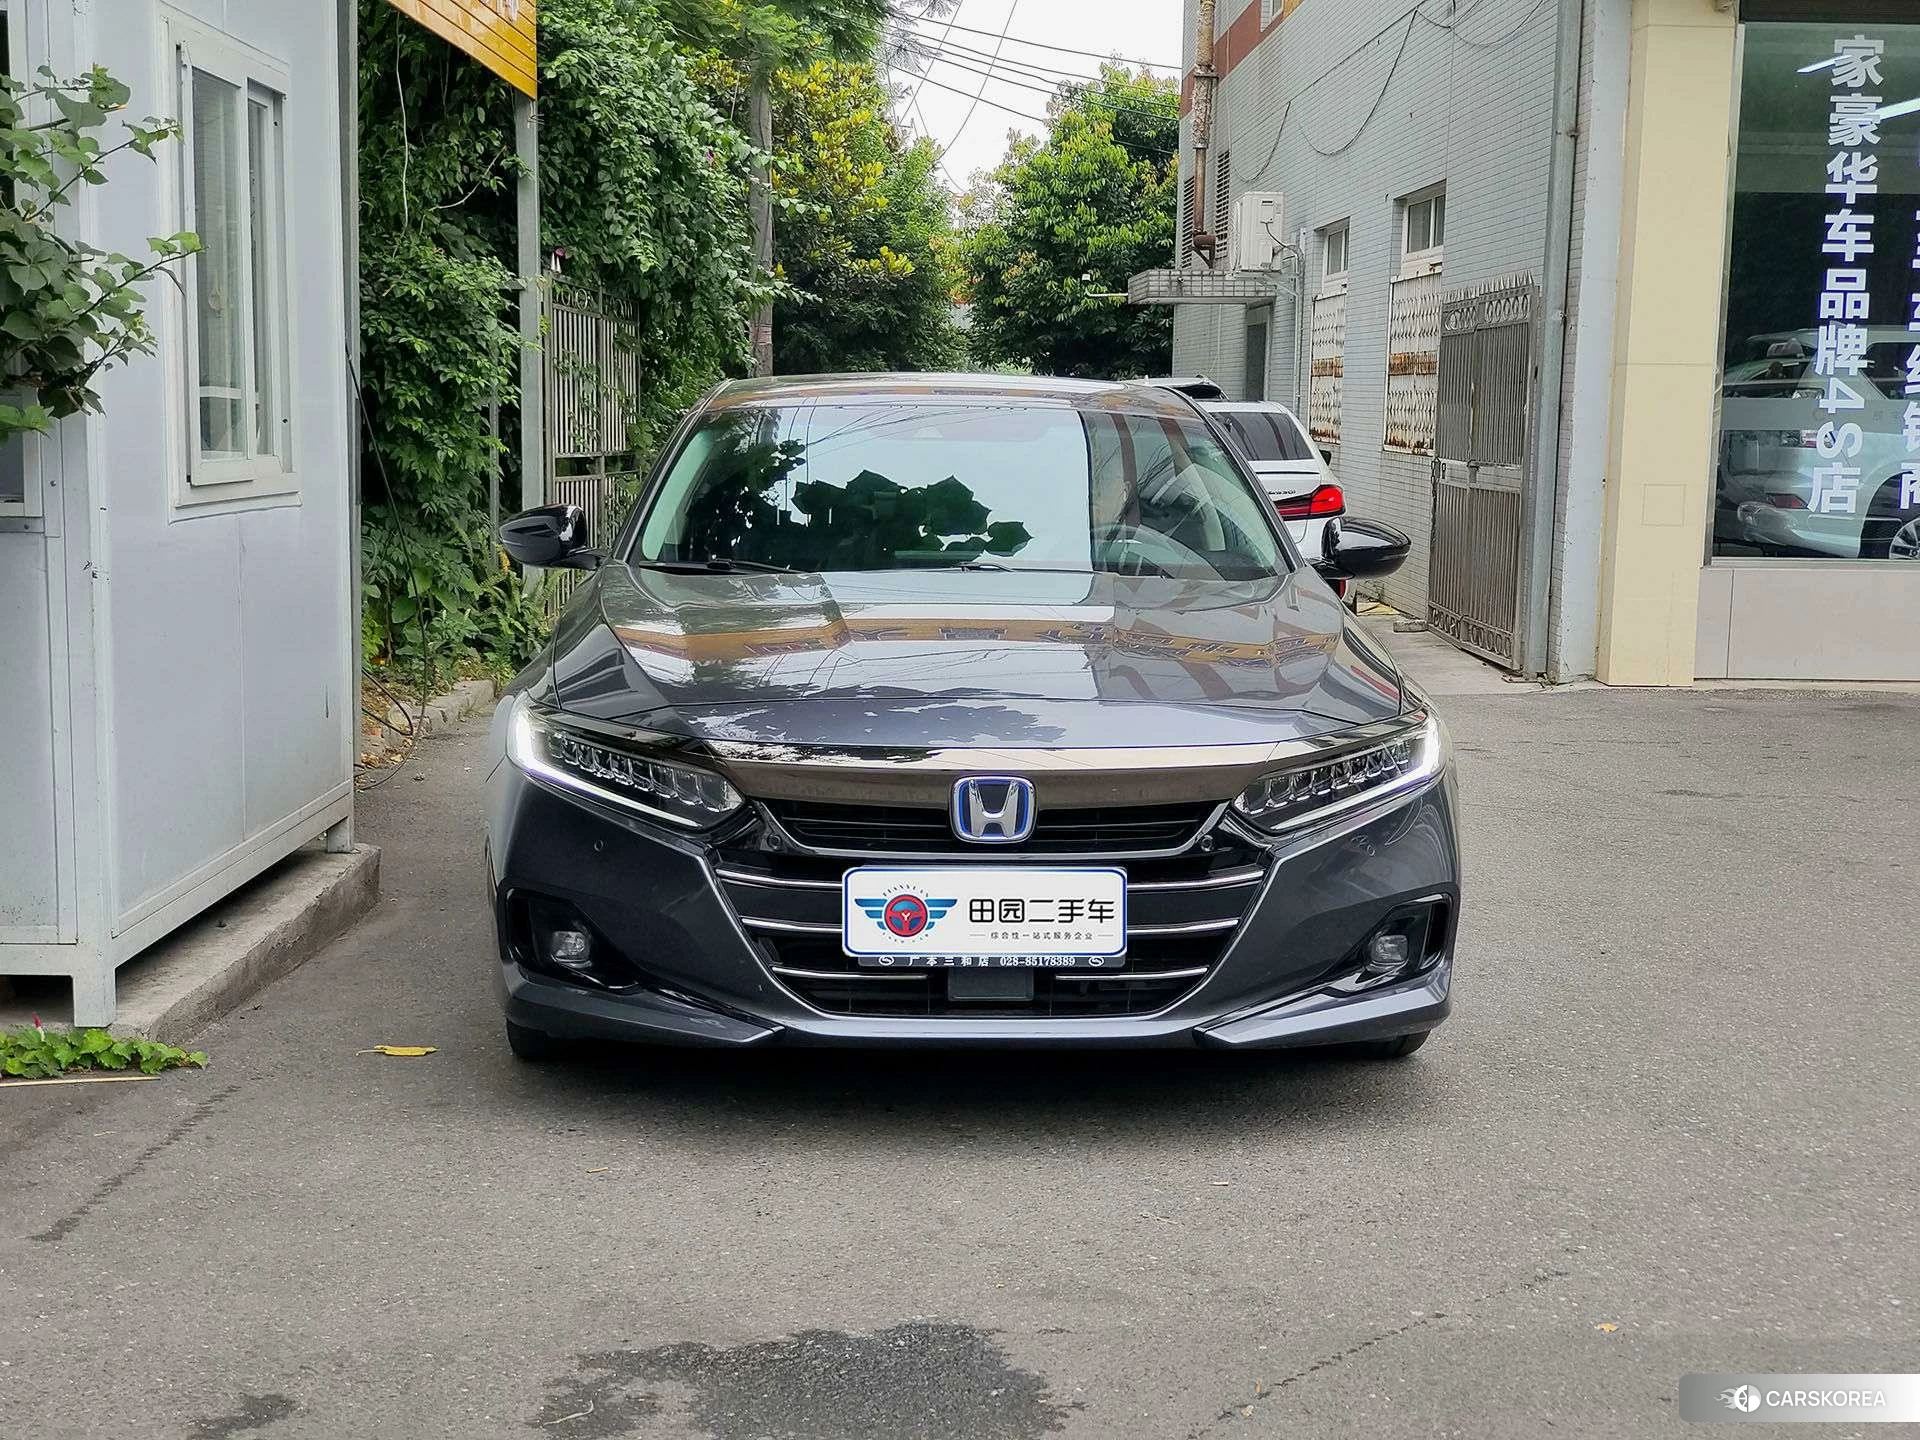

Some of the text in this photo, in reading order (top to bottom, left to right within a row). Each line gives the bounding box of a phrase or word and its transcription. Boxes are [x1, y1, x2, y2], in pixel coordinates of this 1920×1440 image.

[1807, 34, 1885, 515] 家豪华车品牌4S店
[968, 898, 1116, 924] 田园二手车
